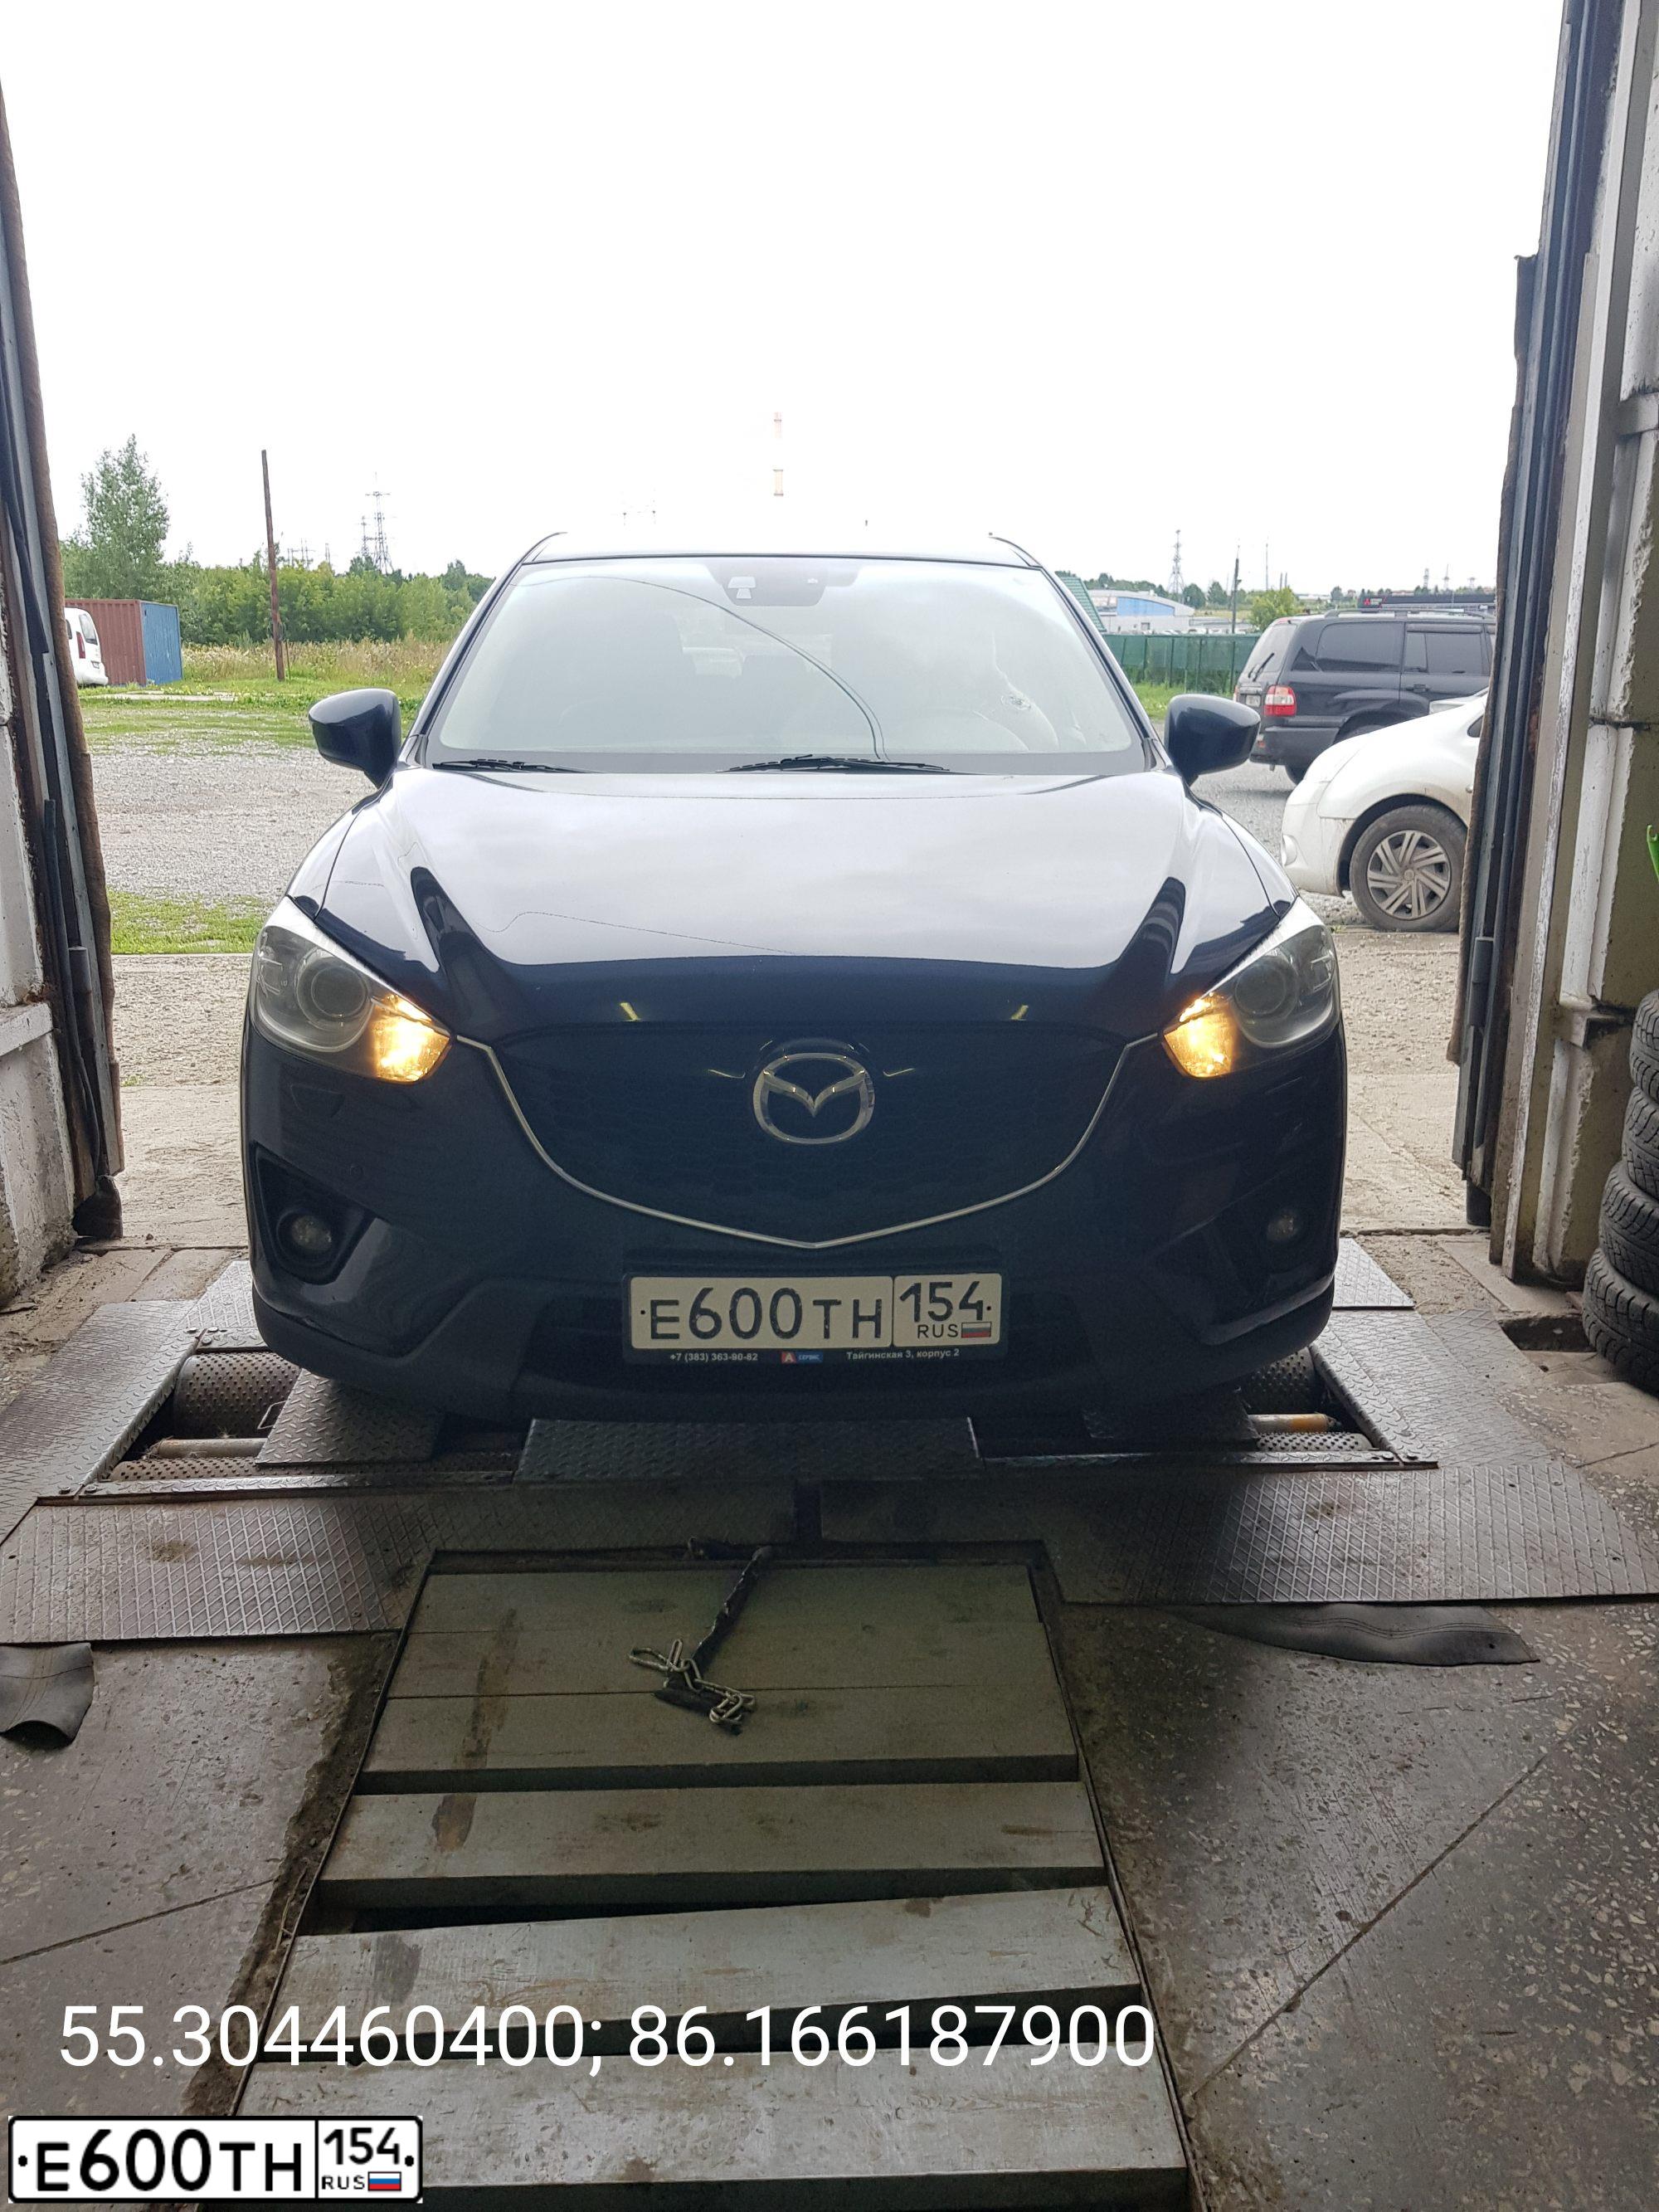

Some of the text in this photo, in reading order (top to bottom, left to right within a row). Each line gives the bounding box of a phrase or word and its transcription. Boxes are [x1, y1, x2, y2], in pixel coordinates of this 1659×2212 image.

[900, 1281, 984, 1323] 154
[917, 1323, 959, 1339] RUS
[669, 1352, 682, 1362] +7
[684, 1352, 709, 1363] (383)
[846, 1348, 960, 1360] Тайгинская 3, корпус 2
